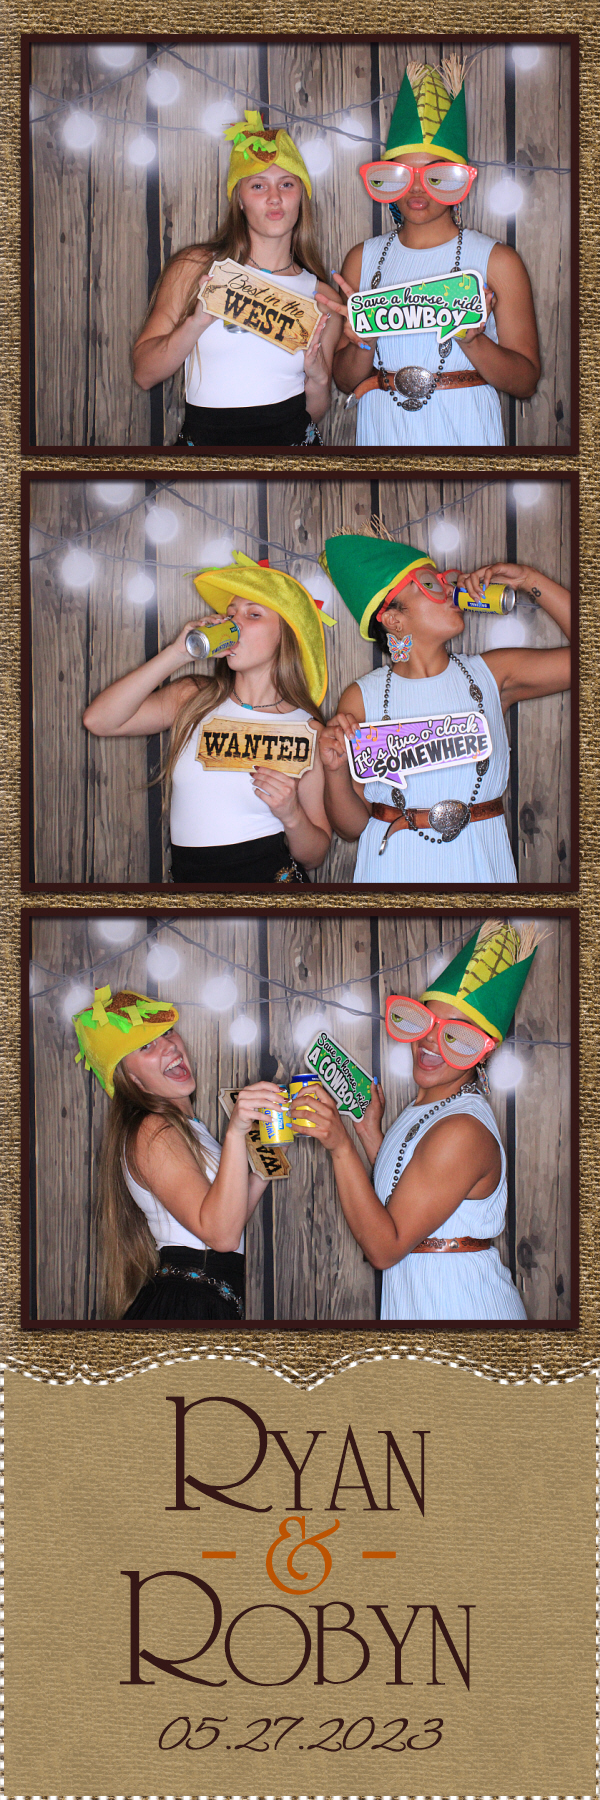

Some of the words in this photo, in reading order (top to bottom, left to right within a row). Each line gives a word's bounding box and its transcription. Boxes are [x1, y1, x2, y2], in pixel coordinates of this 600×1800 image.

[220, 266, 269, 298] Best
[263, 293, 281, 307] in
[281, 301, 305, 318] the
[223, 288, 295, 342] WEST
[351, 295, 388, 311] Save
[391, 295, 401, 304] a
[403, 287, 448, 308] horse,
[453, 296, 483, 312] ride
[355, 311, 373, 333] A
[375, 305, 467, 331] COWBOY
[203, 732, 310, 762] WANTED
[354, 747, 387, 776] It's
[386, 732, 419, 757] five
[420, 714, 479, 740] o'clock
[374, 735, 488, 778] SOMEWHERE
[308, 1046, 322, 1067] A
[319, 1055, 359, 1111] COWBOY
[317, 1032, 337, 1058] Save
[335, 1056, 342, 1065] a
[340, 1059, 357, 1093] horse,
[356, 1092, 369, 1114] ride
[264, 1110, 276, 1139] TWISD
